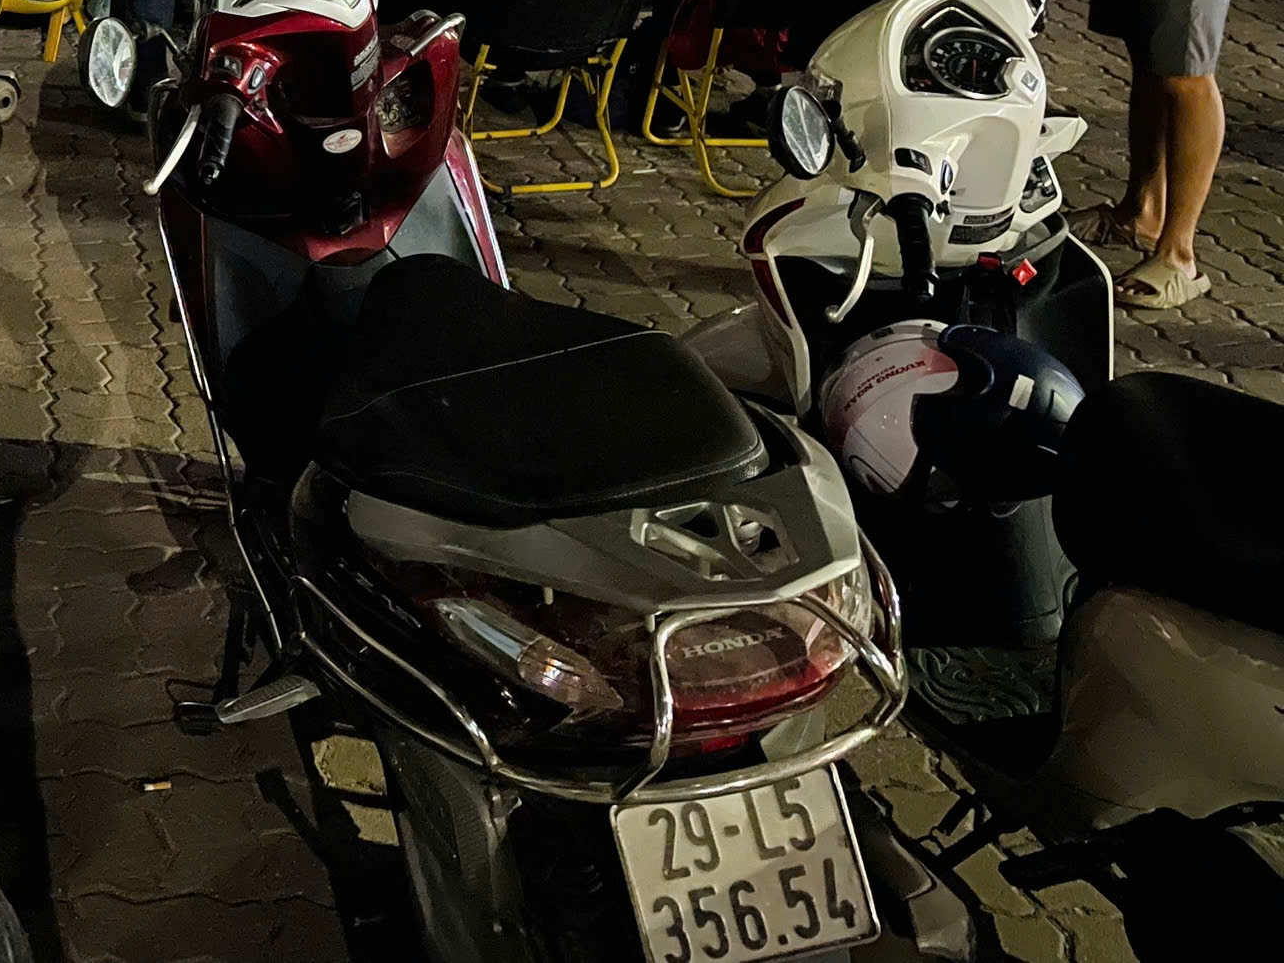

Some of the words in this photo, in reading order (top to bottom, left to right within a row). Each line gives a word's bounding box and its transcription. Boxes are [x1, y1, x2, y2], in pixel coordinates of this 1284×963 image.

[681, 627, 785, 659] HONDA
[648, 777, 817, 881] 29-L5
[652, 858, 857, 963] 356.54
